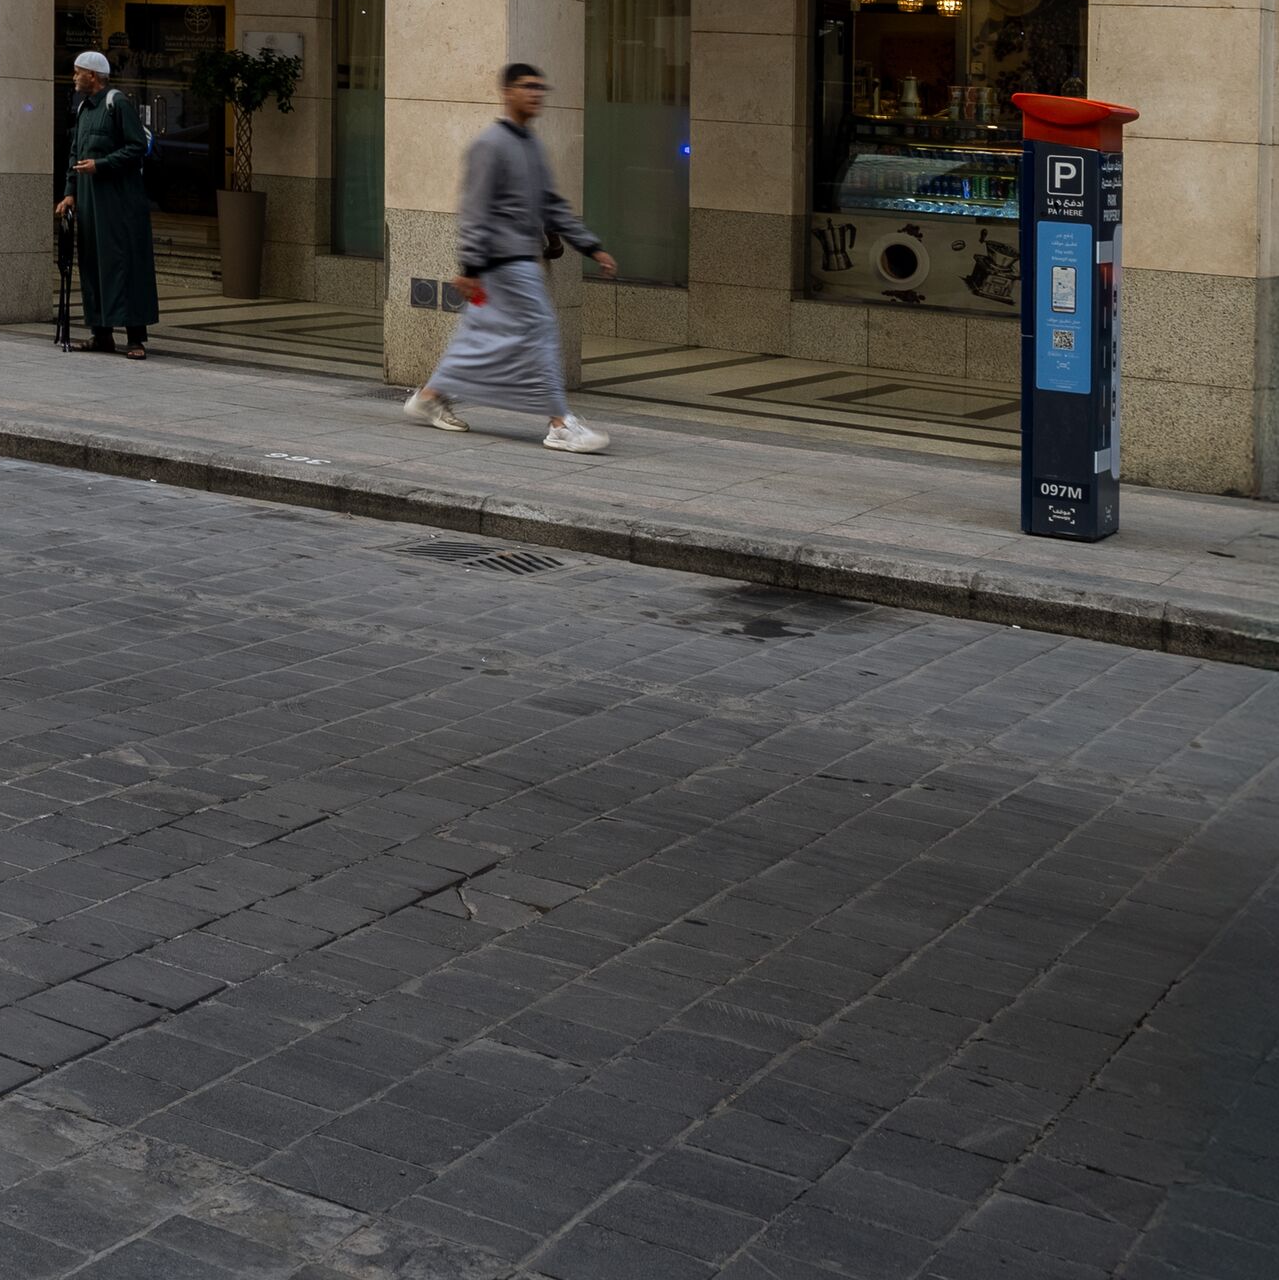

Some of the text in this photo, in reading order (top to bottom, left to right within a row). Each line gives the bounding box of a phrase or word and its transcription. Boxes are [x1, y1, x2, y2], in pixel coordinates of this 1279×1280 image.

[1055, 162, 1077, 189] P
[1064, 209, 1084, 217] HERE
[1040, 482, 1083, 500] 097M
